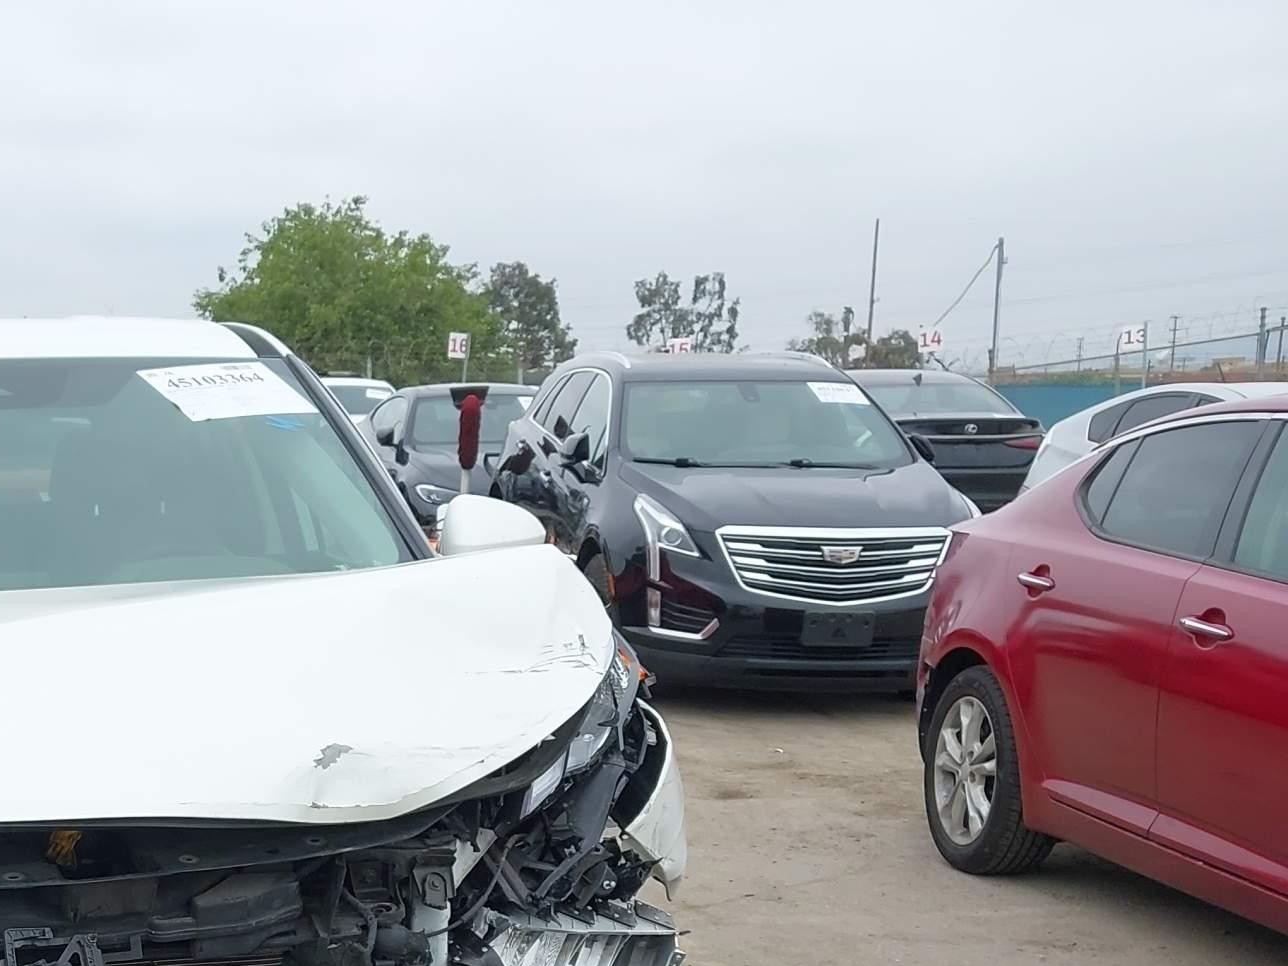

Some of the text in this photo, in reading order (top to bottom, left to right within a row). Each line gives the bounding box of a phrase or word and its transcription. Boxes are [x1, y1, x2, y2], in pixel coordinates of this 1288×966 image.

[920, 330, 942, 347] 14
[1124, 328, 1145, 344] 13
[450, 338, 469, 353] 16
[166, 371, 265, 390] 45103364
